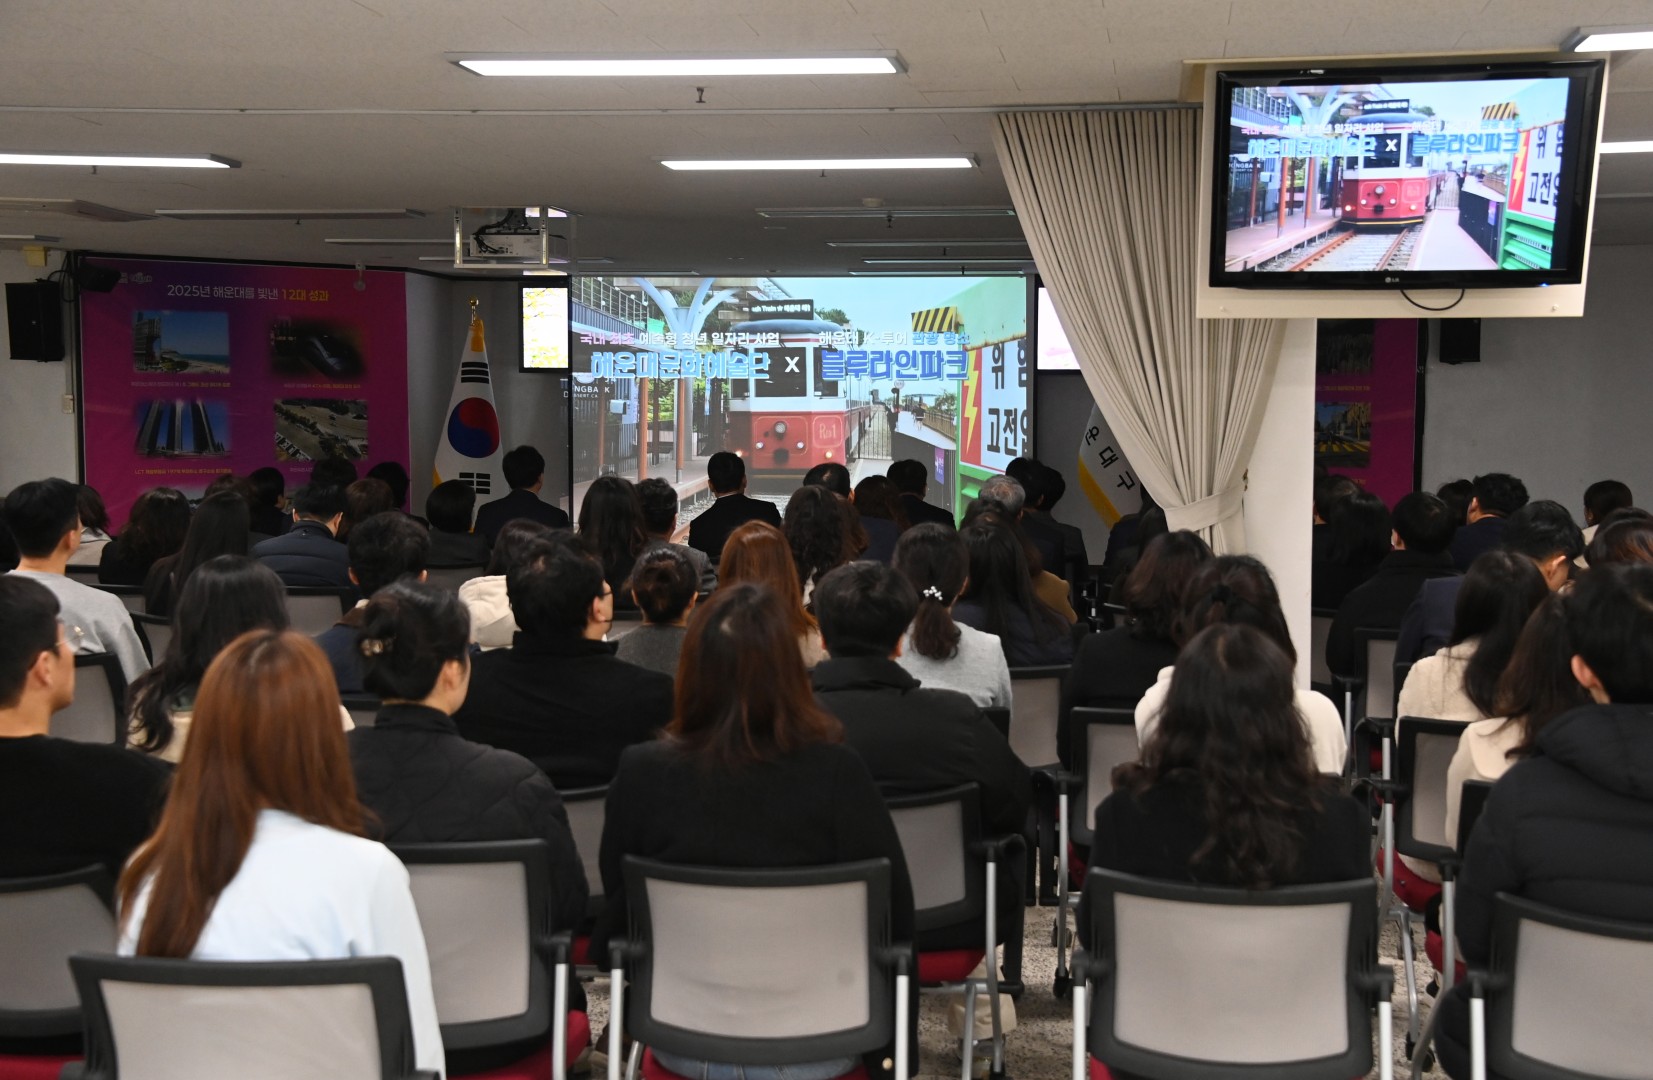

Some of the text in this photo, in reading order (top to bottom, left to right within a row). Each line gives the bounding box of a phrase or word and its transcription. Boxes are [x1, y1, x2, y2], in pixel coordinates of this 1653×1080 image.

[1412, 131, 1521, 157] 블루라인파크
[167, 284, 329, 302] 2025년 해운대를 빛낸 12대 성과
[580, 332, 606, 346] 국내
[609, 332, 635, 346] 최초
[682, 332, 708, 346] 청년
[711, 332, 750, 346] 일자리
[753, 332, 780, 346] 사업
[818, 331, 859, 346] 해운대
[912, 331, 940, 346] 관광
[943, 331, 971, 346] 명소
[590, 351, 771, 379] 해운대문화예술단
[821, 350, 970, 381] 블루라인파크
